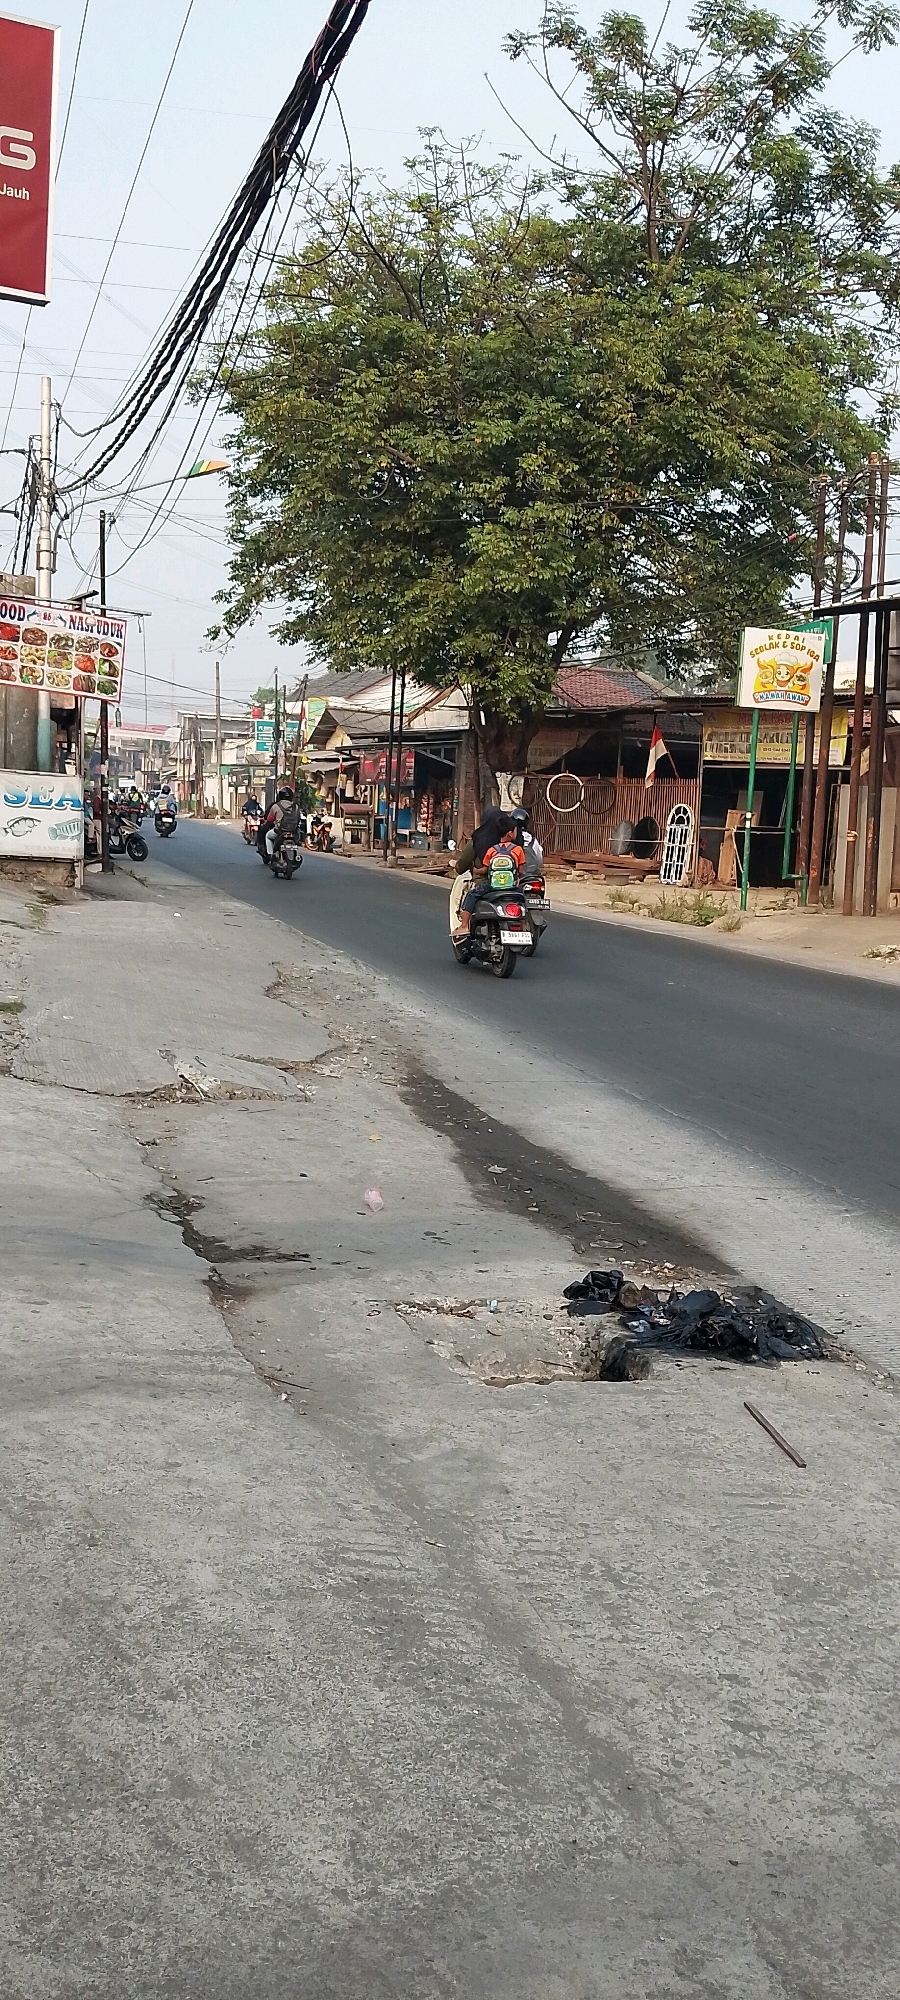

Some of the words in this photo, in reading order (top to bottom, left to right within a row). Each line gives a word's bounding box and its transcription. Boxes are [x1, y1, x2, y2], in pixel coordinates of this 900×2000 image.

[0, 183, 30, 200] Jauh
[0, 602, 26, 621] OOD
[96, 619, 124, 639] UDUK
[768, 633, 806, 643] KEDAI
[749, 641, 780, 658] SEBLAK
[782, 640, 788, 649] &
[790, 641, 806, 652] SOP
[806, 648, 820, 662] IGA
[772, 711, 806, 724] KARA
[4, 785, 83, 811] SEA
